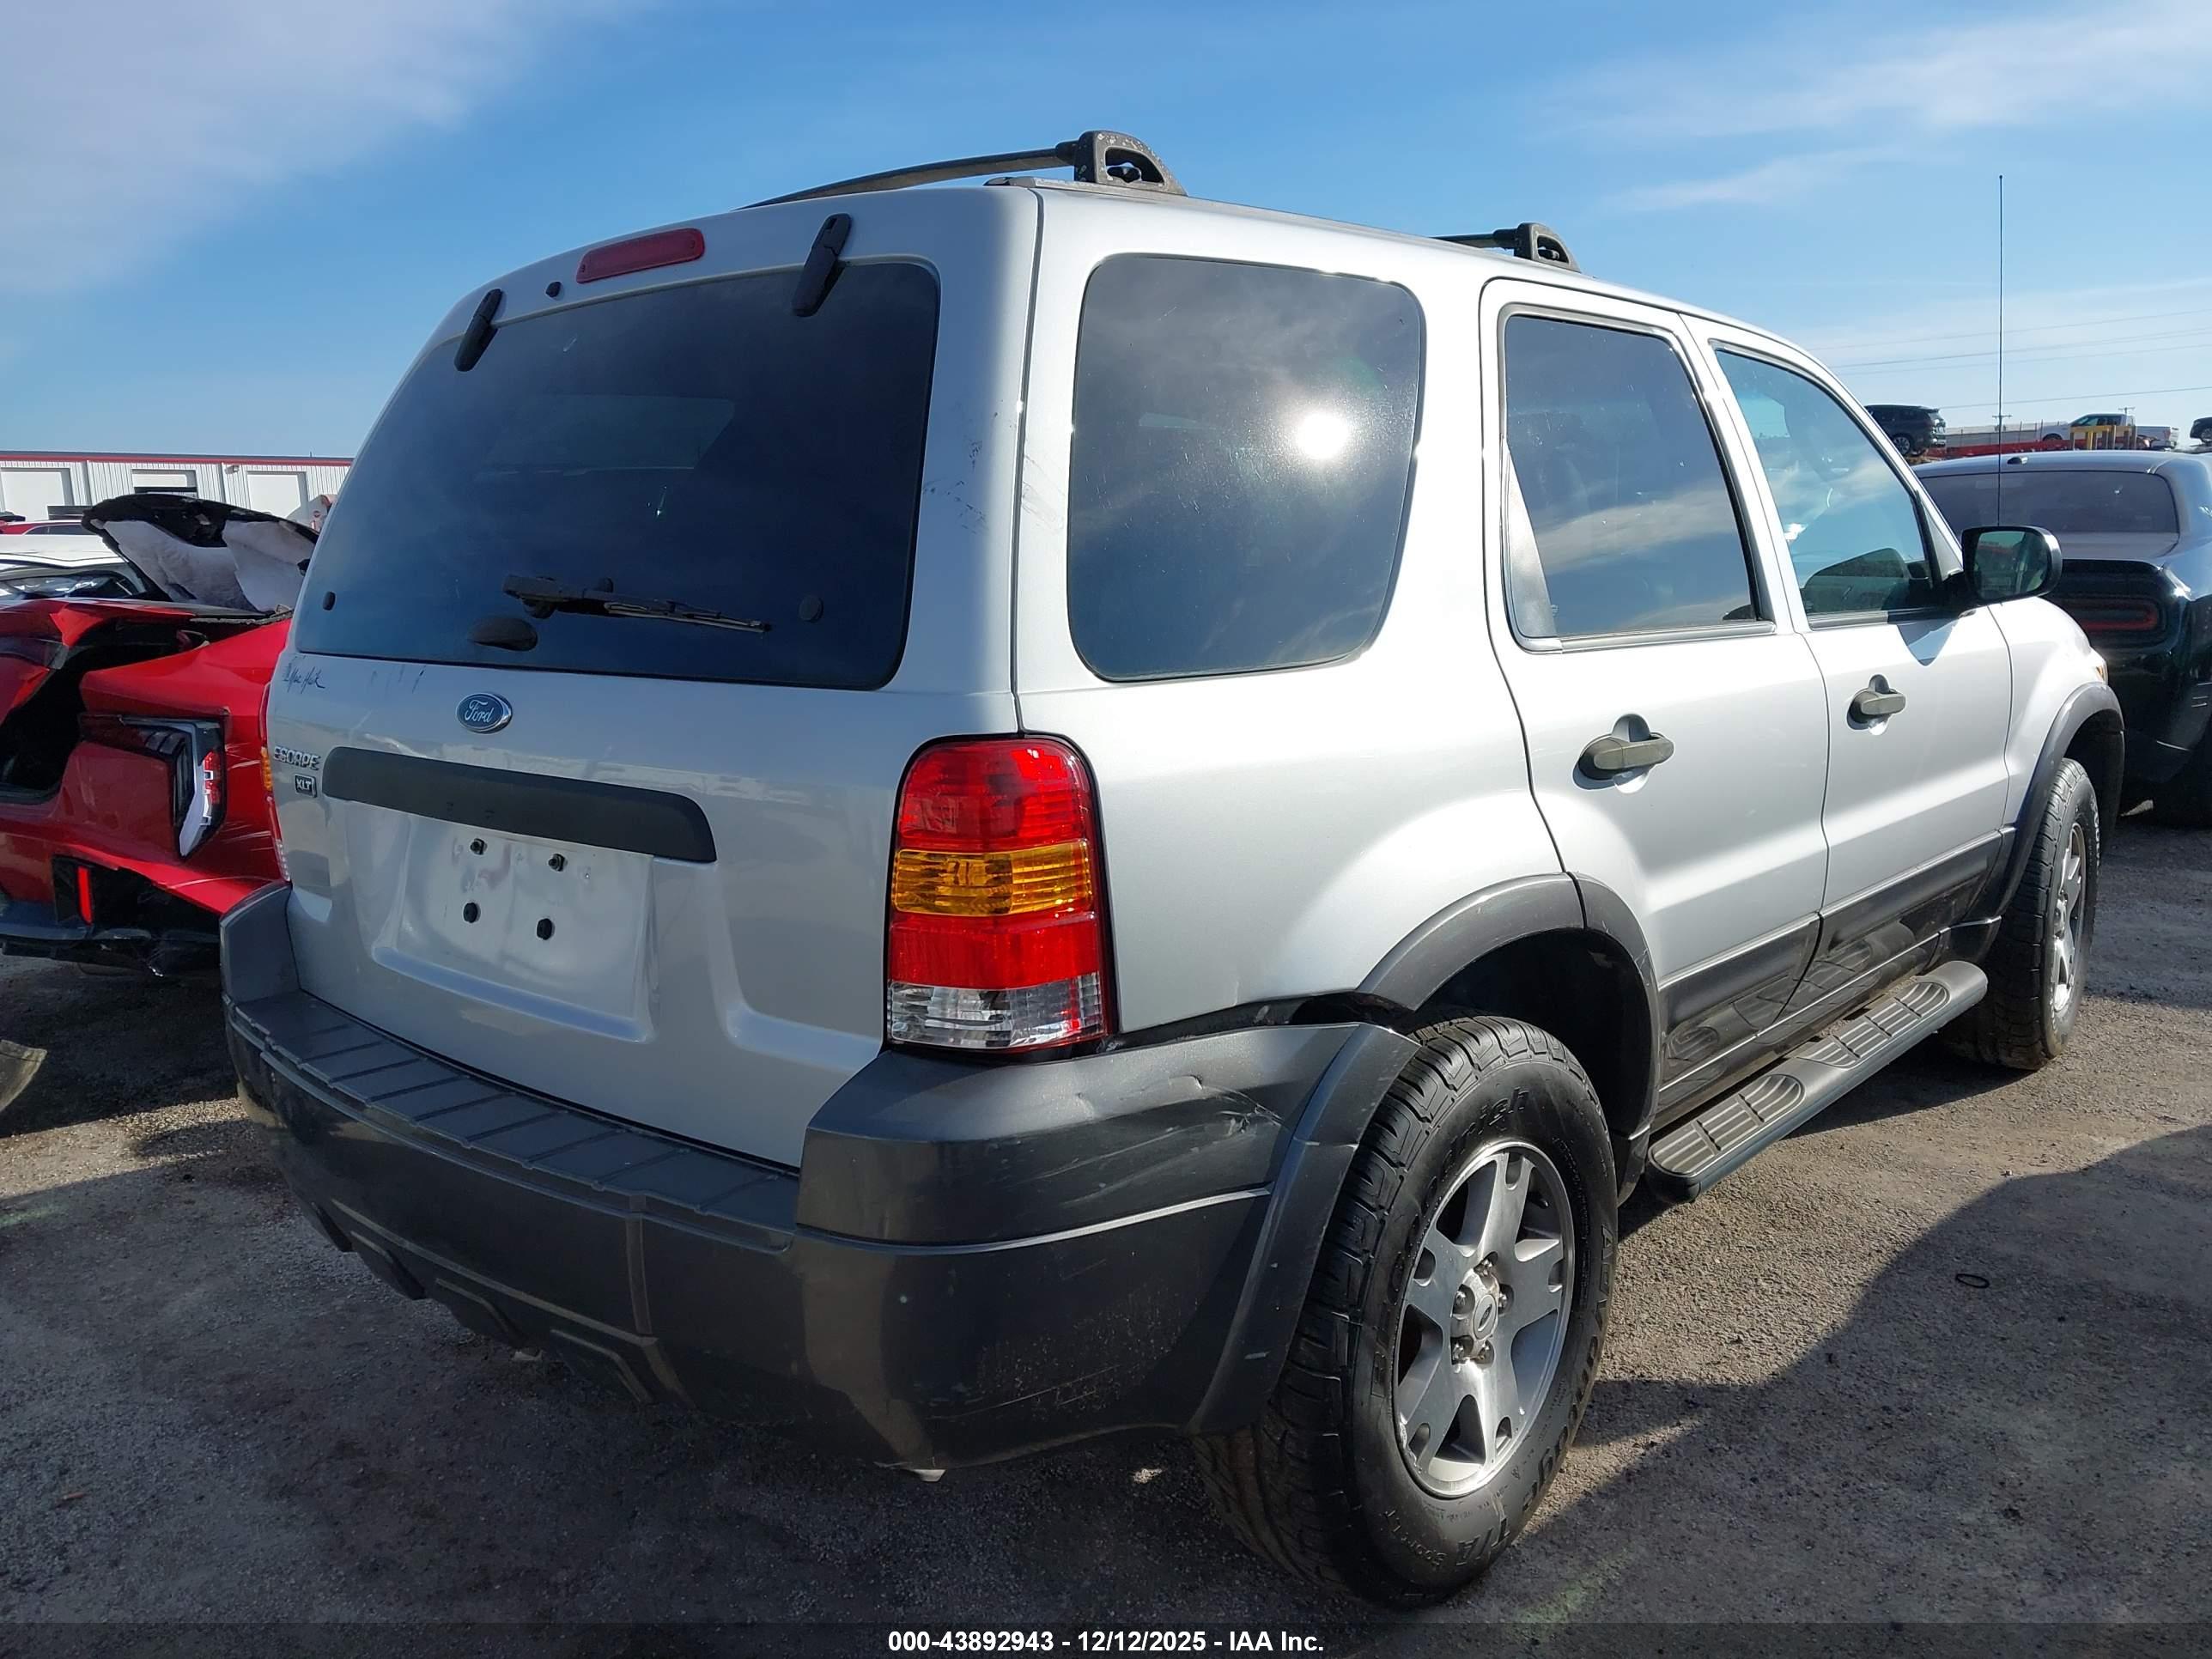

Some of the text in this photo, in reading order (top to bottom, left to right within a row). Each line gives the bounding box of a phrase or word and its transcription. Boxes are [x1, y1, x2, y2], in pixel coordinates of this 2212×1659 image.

[465, 699, 495, 723] Ford
[274, 746, 322, 771] ESCAPE
[296, 778, 313, 792] XLT
